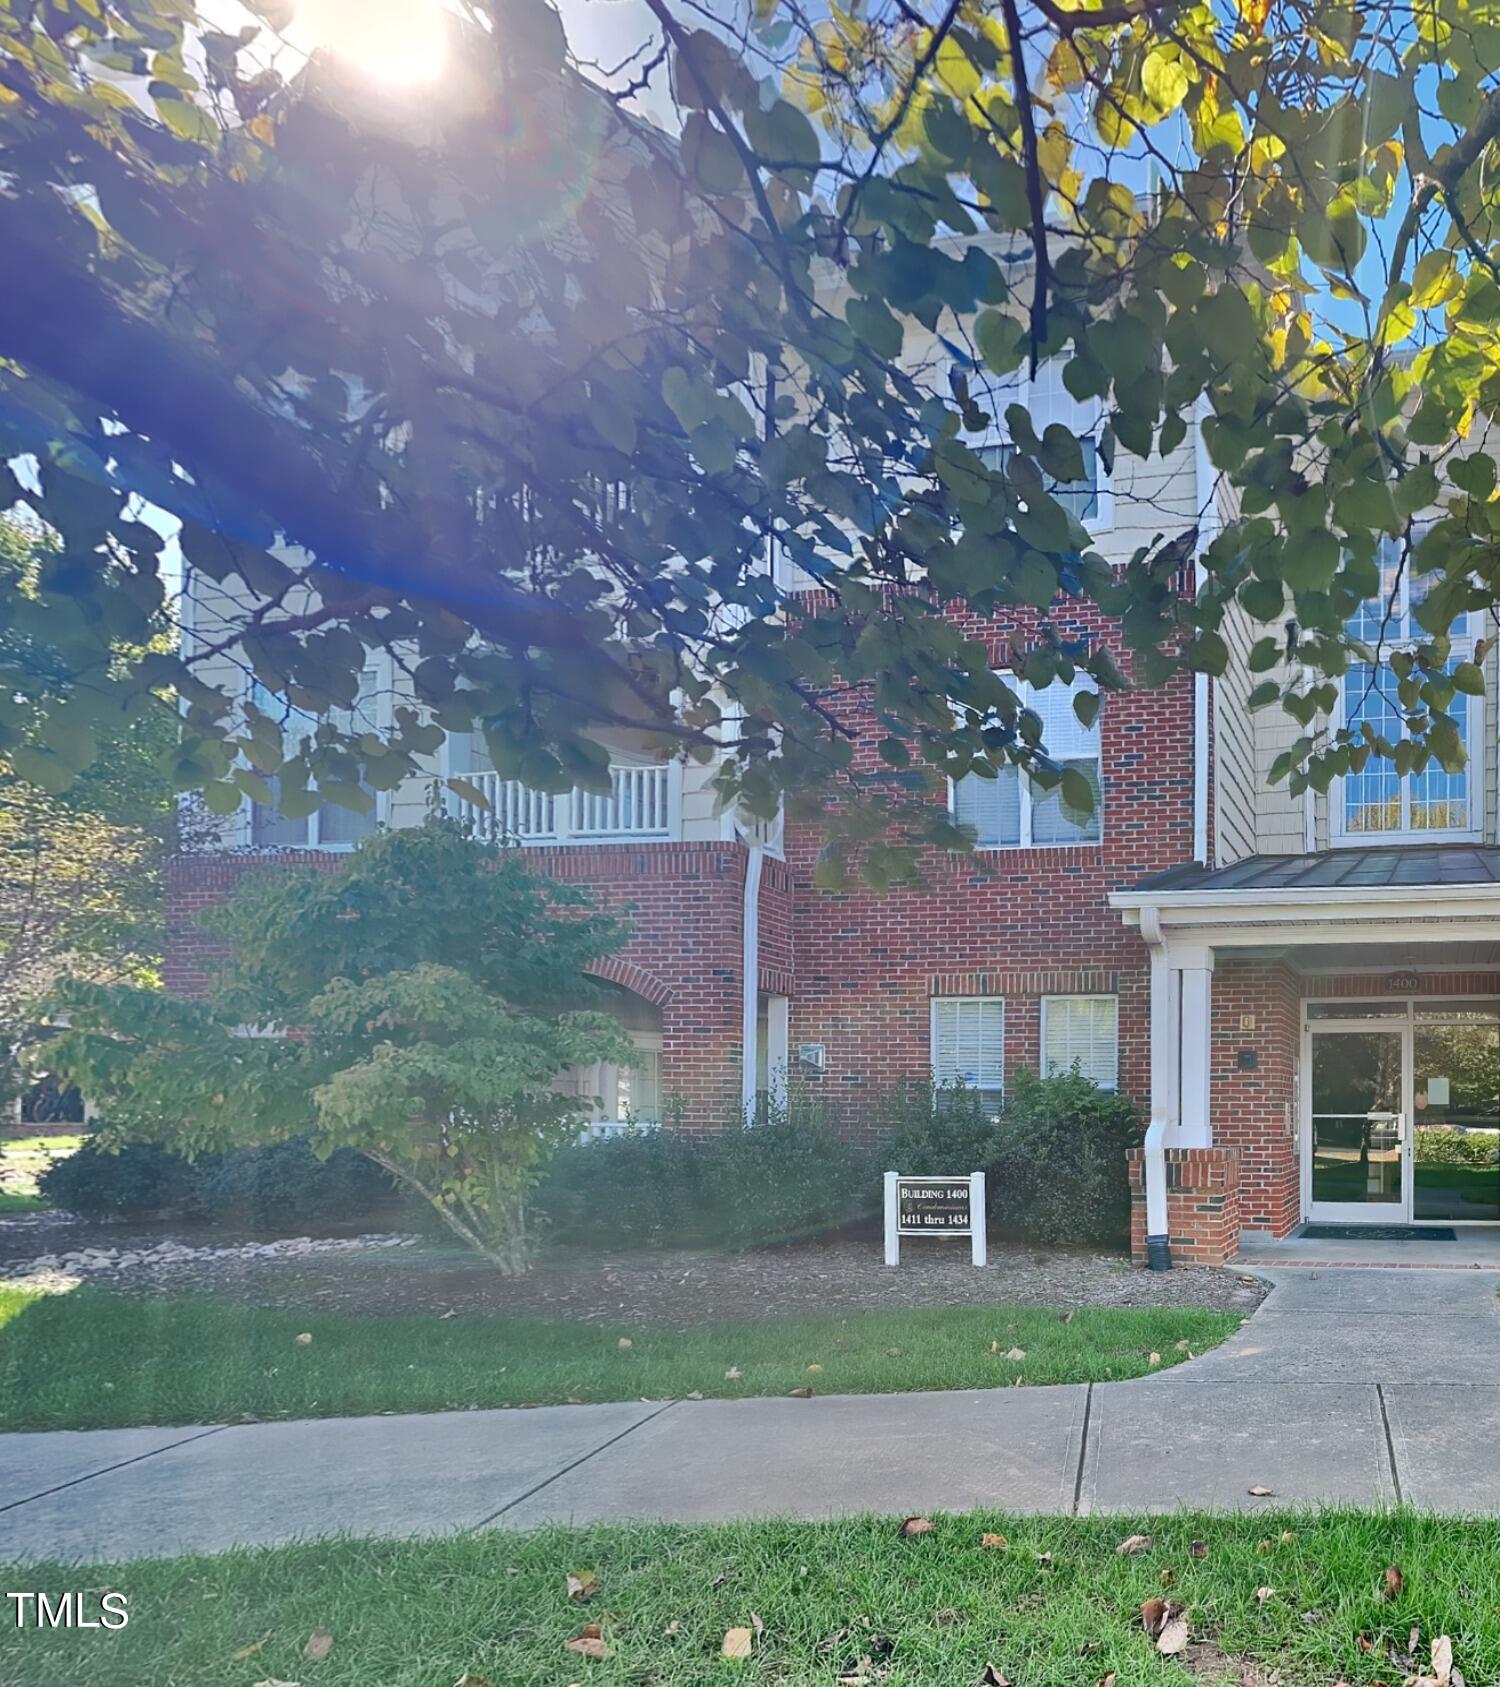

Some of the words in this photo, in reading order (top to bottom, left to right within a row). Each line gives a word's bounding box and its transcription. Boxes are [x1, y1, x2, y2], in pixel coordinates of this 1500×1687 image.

[1388, 978, 1418, 990] 1400
[946, 1189, 968, 1199] 1400
[901, 1214, 921, 1225] 1411
[924, 1213, 945, 1225] thru
[948, 1214, 968, 1225] 1434
